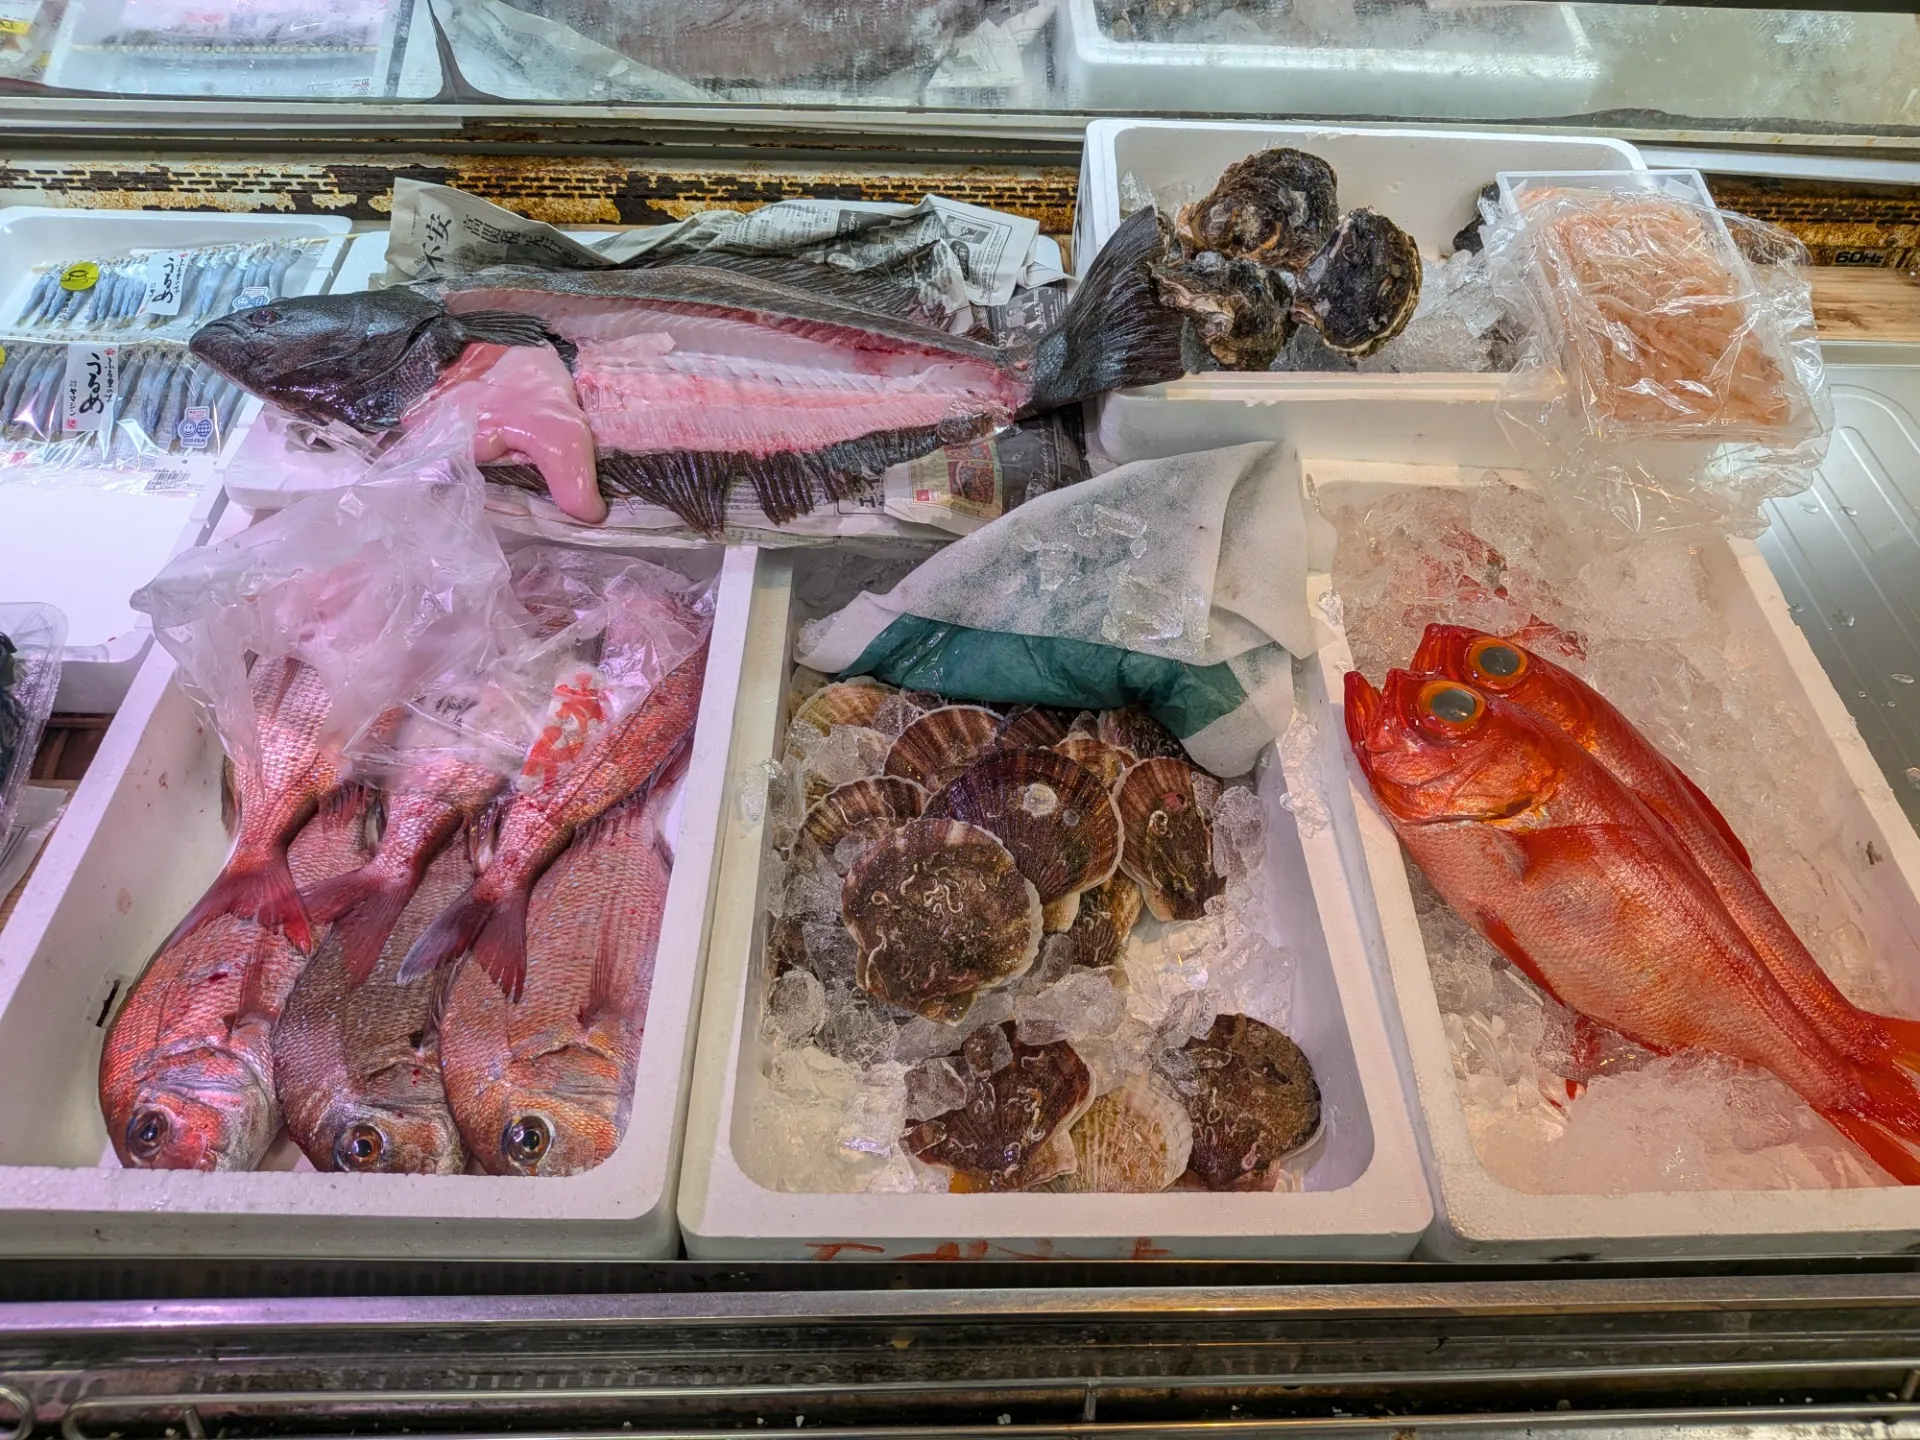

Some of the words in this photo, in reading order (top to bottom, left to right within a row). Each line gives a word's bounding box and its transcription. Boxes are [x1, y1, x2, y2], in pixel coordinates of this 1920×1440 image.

[151, 257, 174, 303] うるめ
[1834, 251, 1884, 263] 60Hz
[78, 352, 104, 415] うるめ
